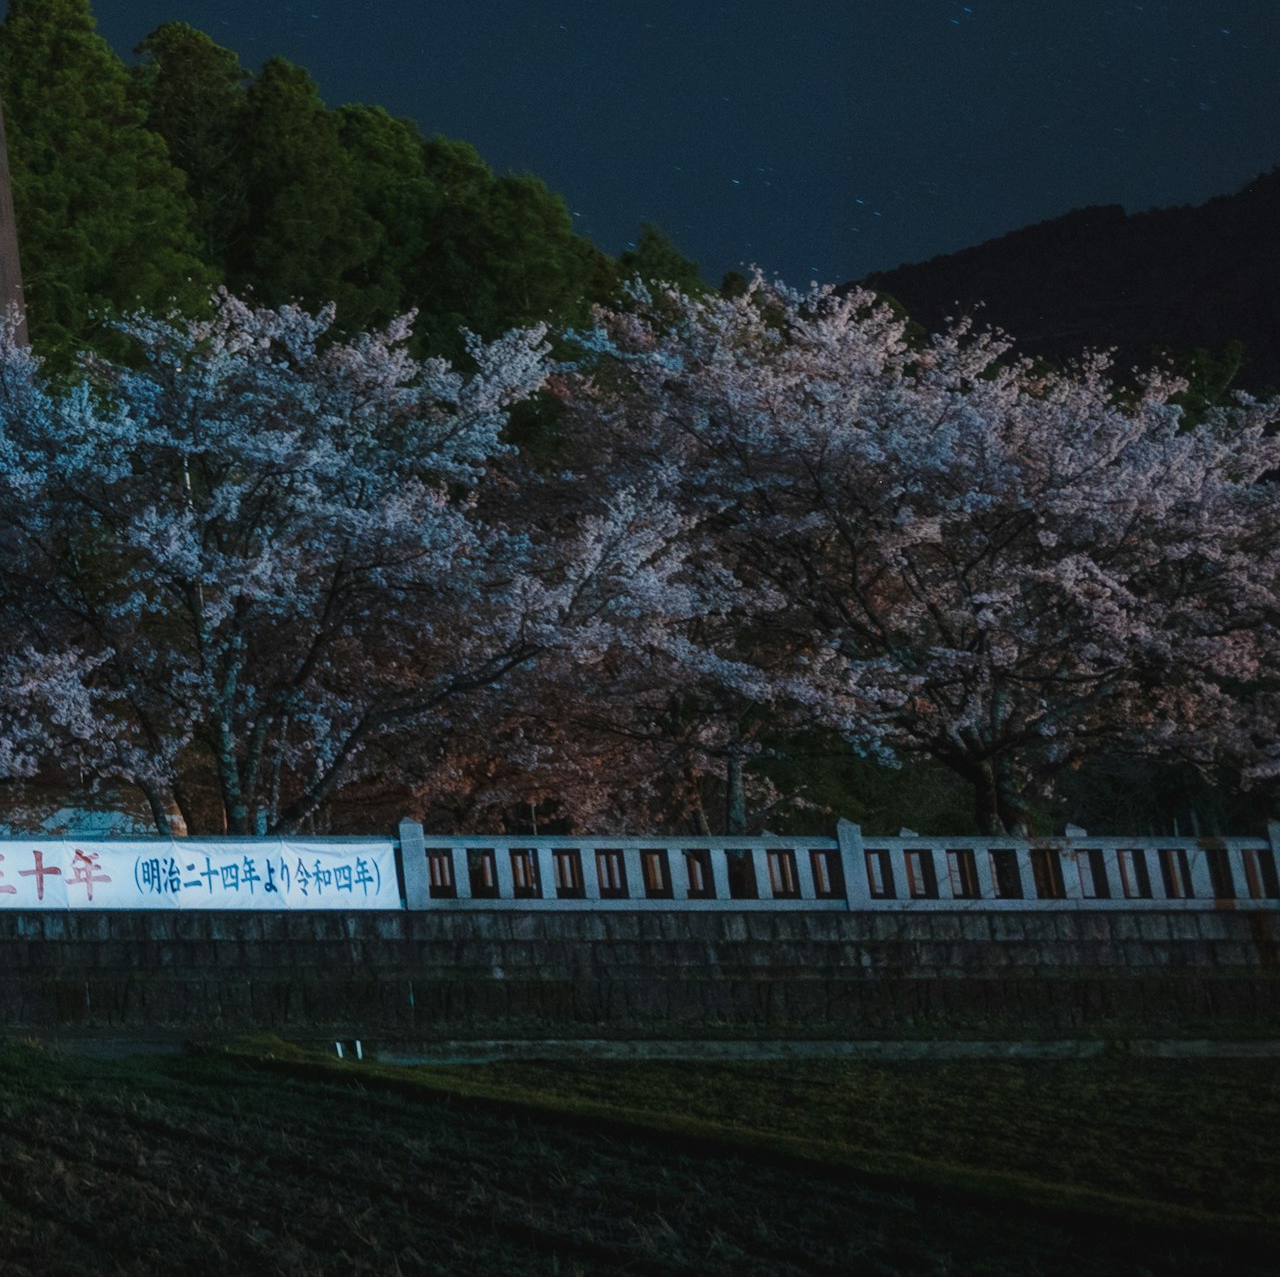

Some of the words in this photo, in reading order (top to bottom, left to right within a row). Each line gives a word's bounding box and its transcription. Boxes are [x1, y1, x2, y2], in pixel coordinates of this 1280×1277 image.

[134, 854, 381, 897] (明治二十四年より令和四年)
